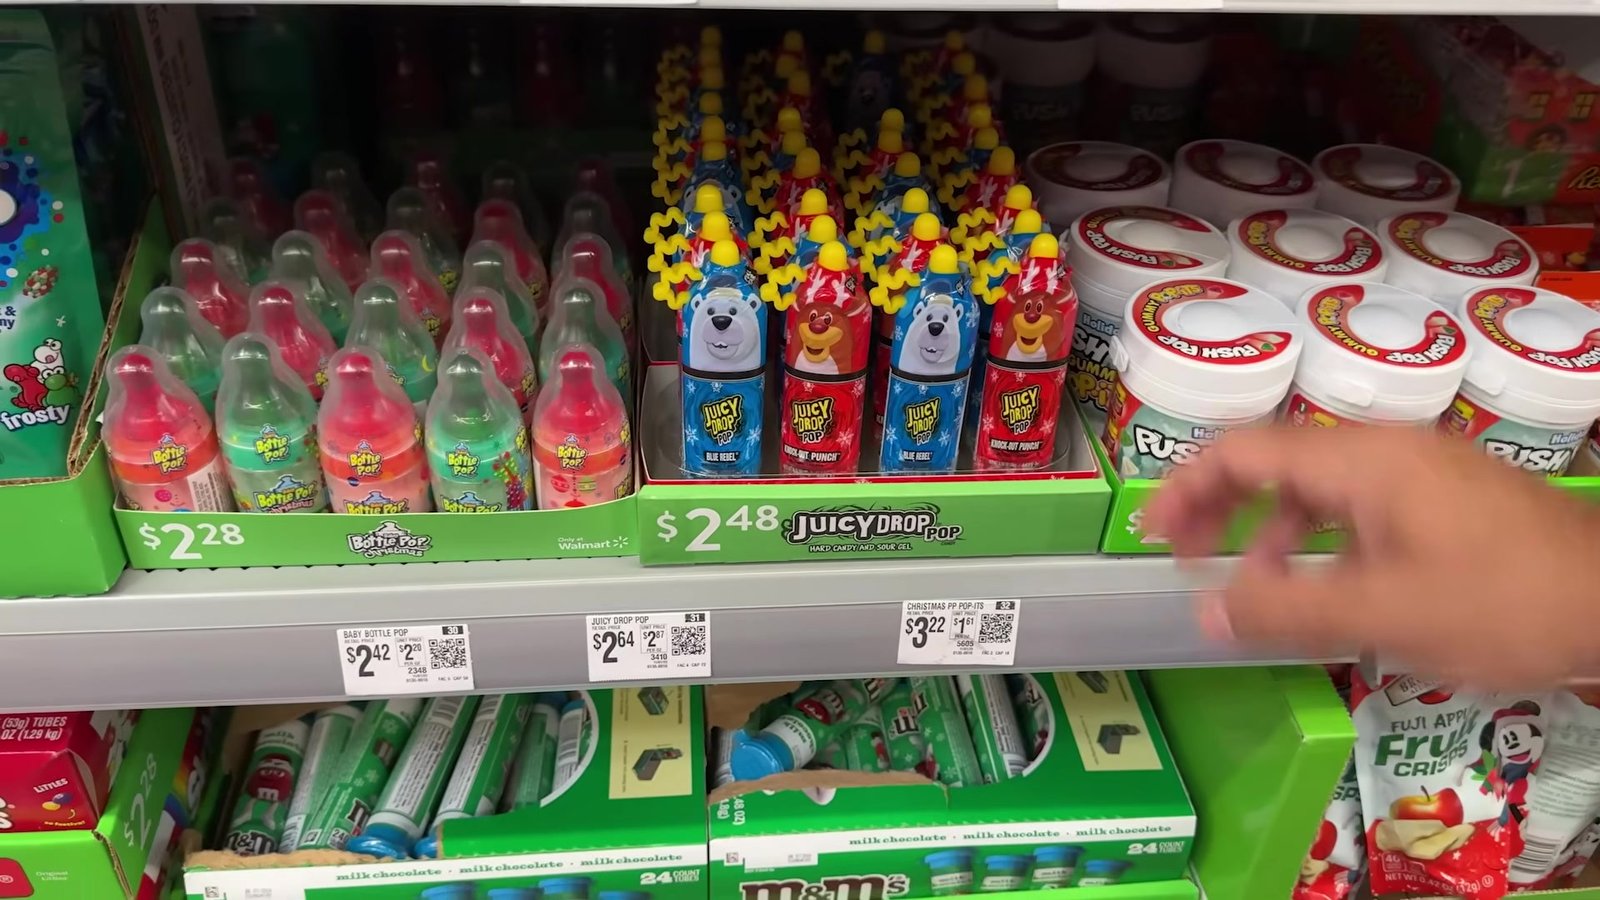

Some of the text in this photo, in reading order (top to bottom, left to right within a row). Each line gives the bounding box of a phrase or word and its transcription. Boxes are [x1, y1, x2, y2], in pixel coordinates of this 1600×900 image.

[1142, 299, 1160, 333] GUMMY
[1329, 324, 1379, 357] GUMMY
[1481, 317, 1522, 352] GUMMY
[1157, 334, 1262, 359] PUSH POP
[1385, 333, 1455, 365] PUSH POP
[1527, 346, 1600, 368] USH POP
[1002, 386, 1039, 414] JUICY
[0, 405, 70, 431] frosty
[704, 397, 741, 427] JUICY
[793, 398, 833, 424] JUICY
[907, 398, 940, 428] JUICY
[1009, 405, 1033, 424] DROP
[711, 416, 735, 435] DROP
[797, 417, 824, 432] DROP
[912, 417, 934, 435] DROP
[1013, 421, 1030, 435] POP
[717, 431, 732, 446] POP
[803, 431, 823, 443] POP
[917, 431, 931, 446] POP
[990, 439, 1040, 451] KNOCK-OUT PUNCH
[706, 451, 737, 461] BLUE REBEL
[811, 451, 838, 461] PUNCH
[903, 451, 915, 461] BLUE
[925, 525, 964, 541] POP
[558, 540, 611, 551] Walmart
[809, 542, 913, 552] HARD CANDY AND SOUR GEL
[906, 601, 985, 611] CHRISTMAS PP POP-ITS
[1000, 601, 1011, 610] 32
[591, 616, 650, 626] JUICY DROP POP
[689, 613, 700, 622] 31
[343, 628, 409, 639] BABY BOTTLE POP
[447, 626, 459, 635] 30
[650, 653, 668, 661] 3410
[407, 667, 428, 675] 2348
[2, 716, 68, 730] (53g) TUBES
[1391, 714, 1427, 732] FUJI
[1, 728, 62, 741] OZ (1.29 kg)
[33, 778, 69, 794] LITTLES
[1127, 843, 1158, 855] 24
[640, 870, 673, 885] 24
[1385, 873, 1402, 881] NET
